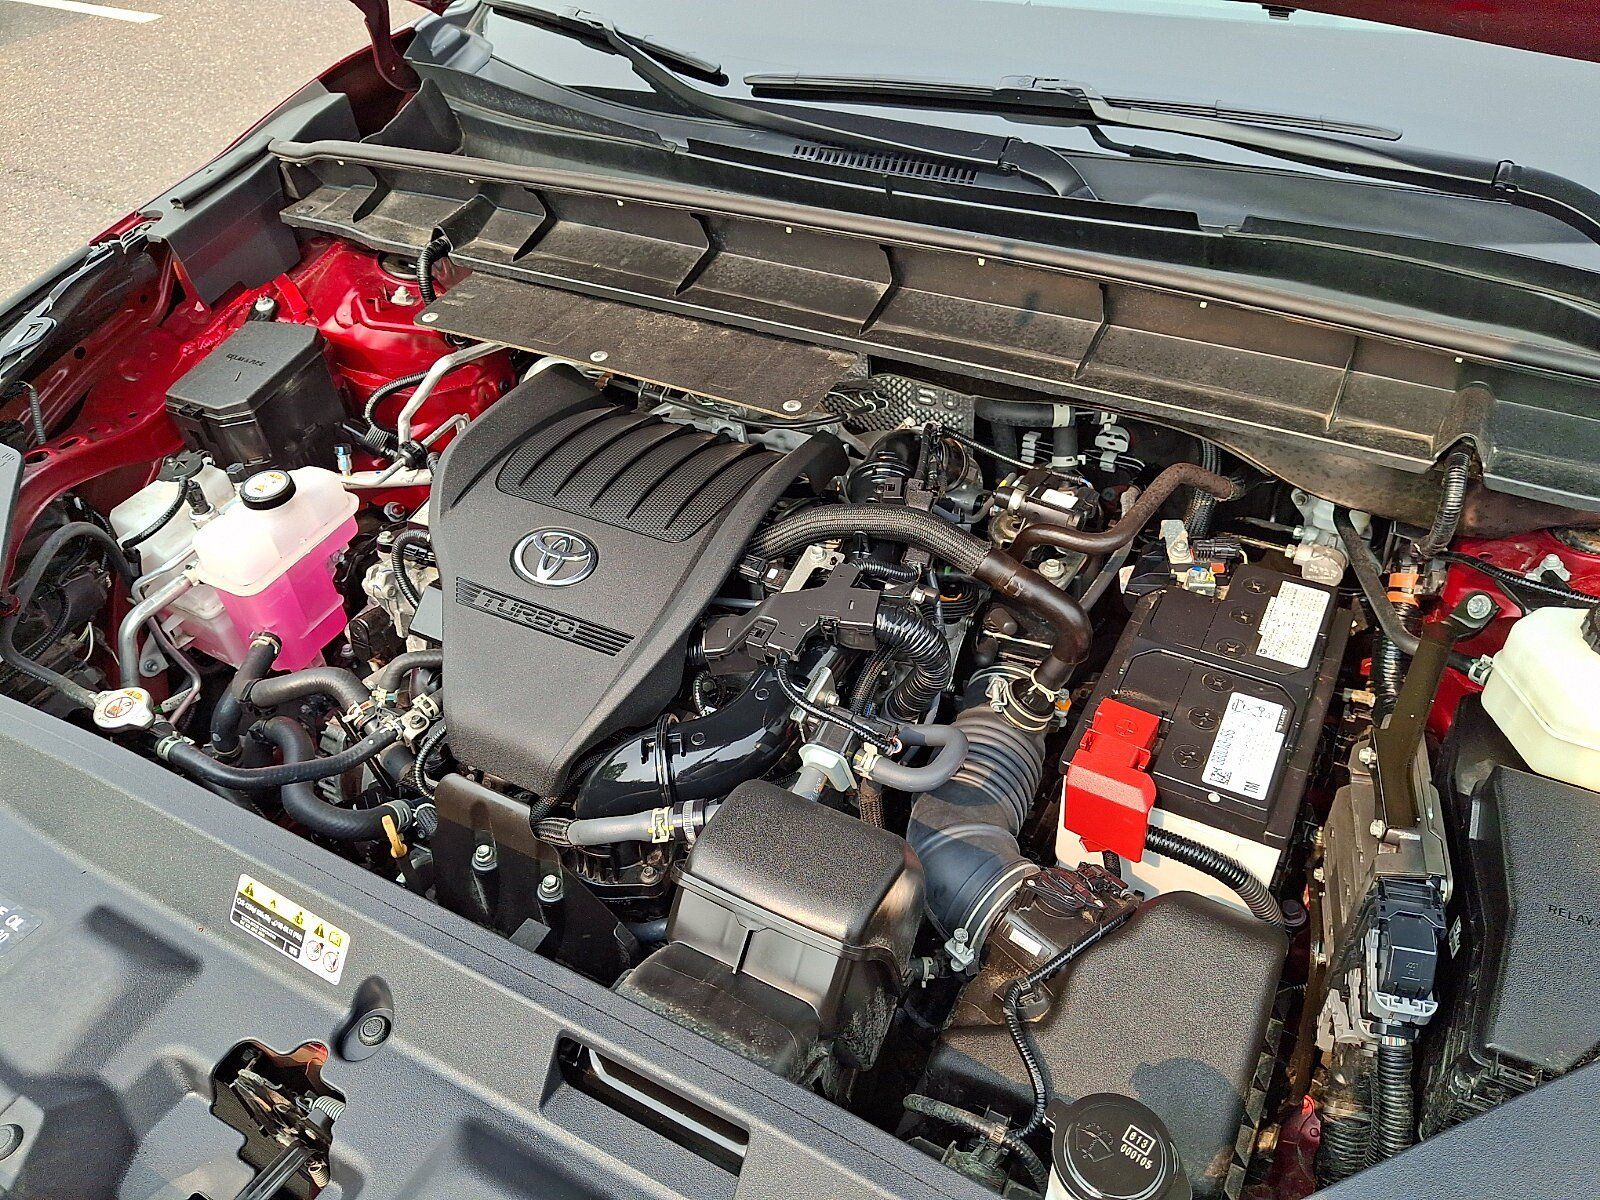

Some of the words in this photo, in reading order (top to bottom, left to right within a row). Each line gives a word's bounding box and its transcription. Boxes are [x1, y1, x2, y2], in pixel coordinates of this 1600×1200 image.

[481, 591, 576, 634] TURBO
[1548, 904, 1594, 925] RELAY
[1120, 1143, 1153, 1169] 000105
